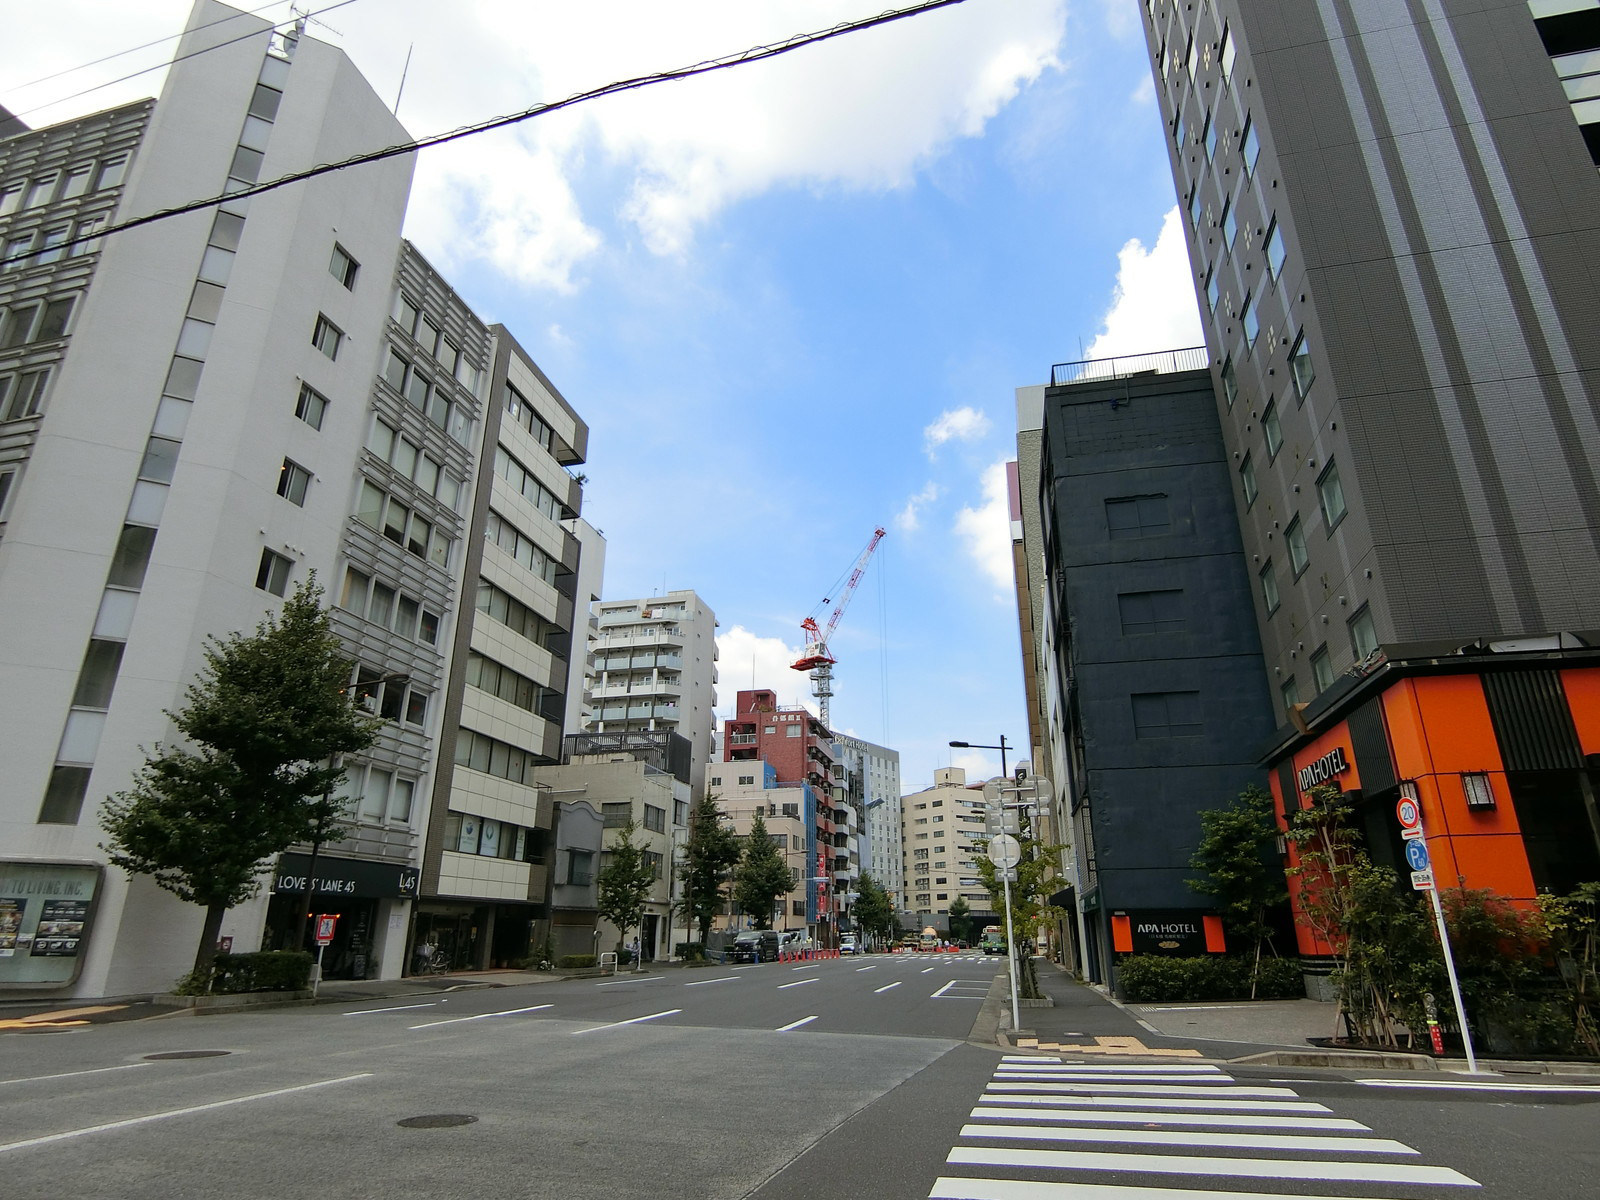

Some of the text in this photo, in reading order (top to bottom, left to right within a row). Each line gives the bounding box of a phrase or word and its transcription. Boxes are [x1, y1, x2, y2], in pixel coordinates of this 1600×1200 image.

[1298, 748, 1346, 791] APA HOTEL
[1401, 805, 1414, 821] 20
[1409, 848, 1420, 867] P
[320, 878, 344, 892] LANE
[344, 880, 356, 893] 45
[1137, 923, 1198, 933] APA HOTEL
